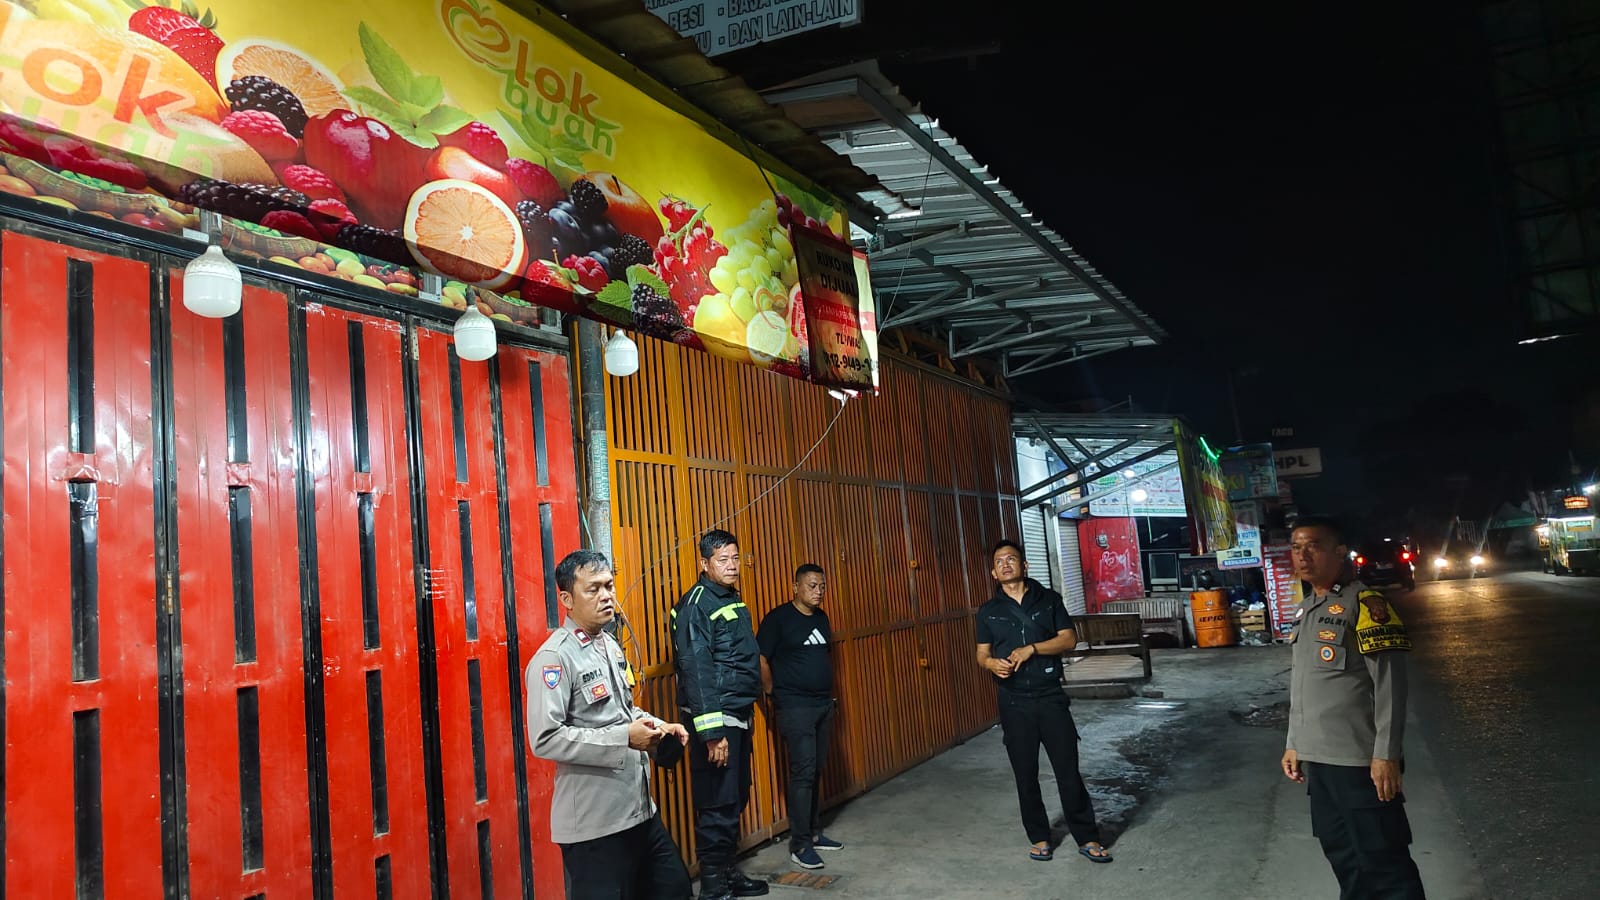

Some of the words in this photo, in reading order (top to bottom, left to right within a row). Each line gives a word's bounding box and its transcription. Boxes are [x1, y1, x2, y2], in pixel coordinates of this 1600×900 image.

[668, 3, 704, 32] BESI
[728, 16, 763, 47] DAN
[767, 0, 853, 36] LAIN-LAIN
[503, 69, 618, 156] buah
[1265, 559, 1280, 630] BENGKEL
